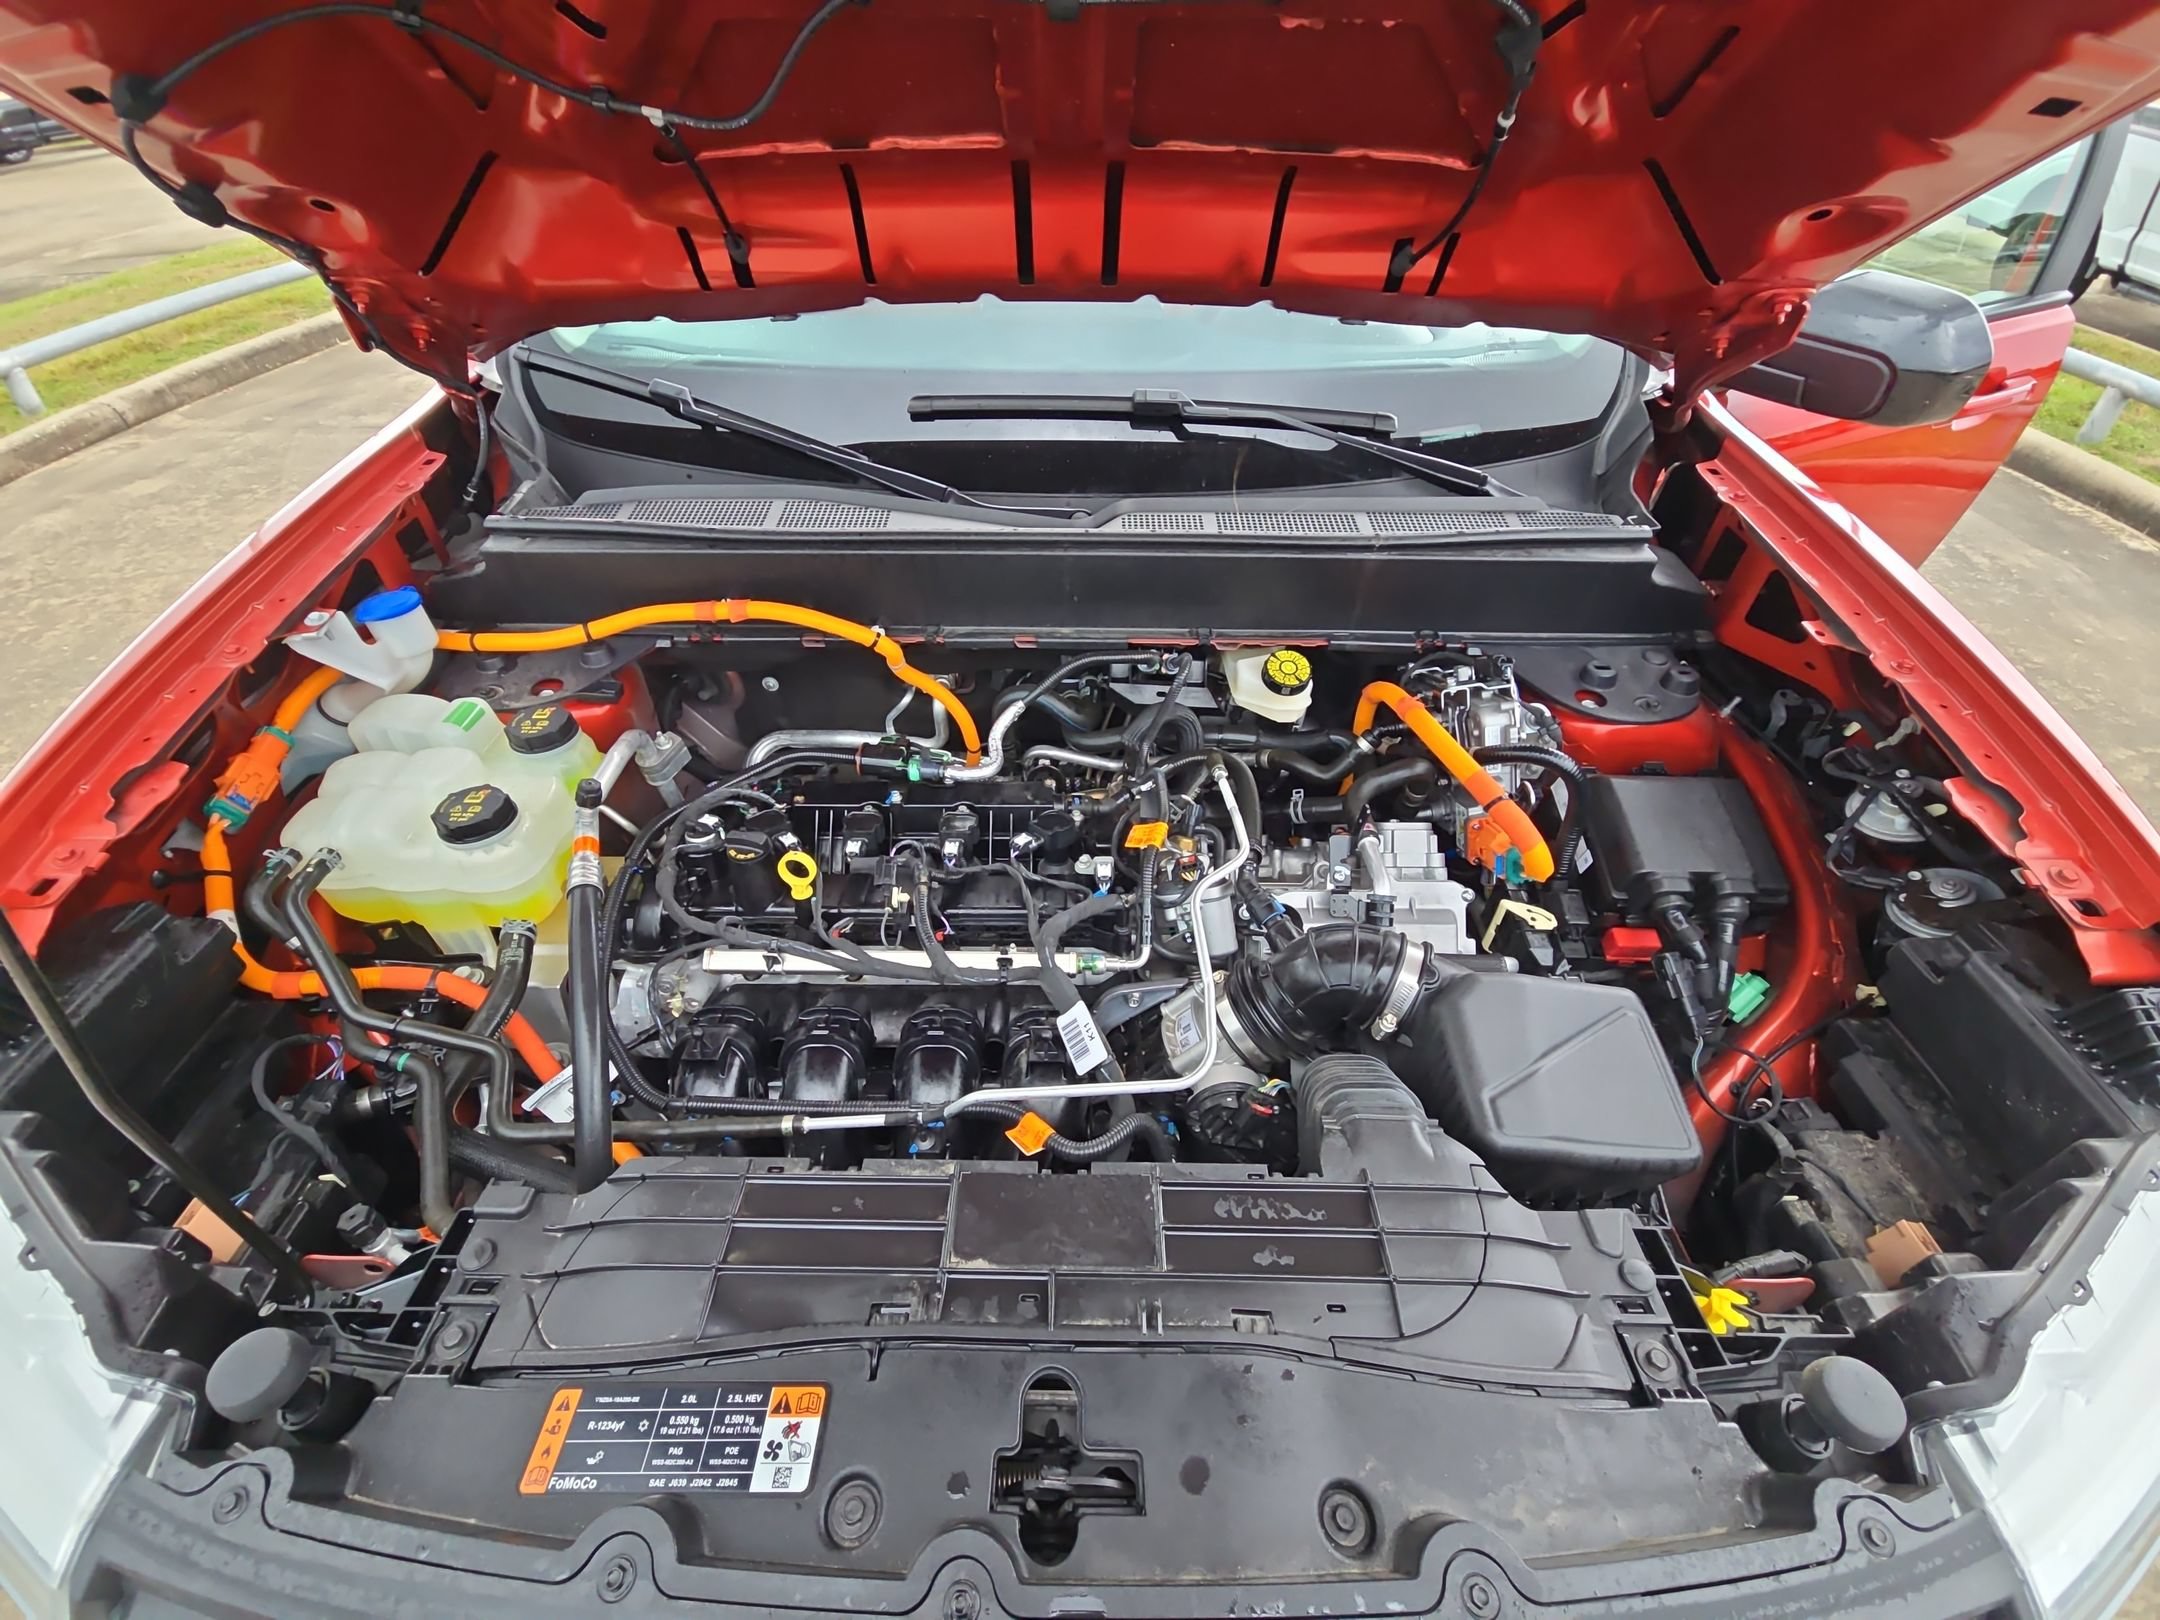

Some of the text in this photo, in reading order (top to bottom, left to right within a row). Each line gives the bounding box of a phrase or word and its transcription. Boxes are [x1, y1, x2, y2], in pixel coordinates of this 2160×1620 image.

[1083, 1022, 1095, 1041] K11
[680, 1395, 698, 1404] 2.0L
[727, 1394, 763, 1404] 2.5L HEV
[669, 1416, 700, 1427] 0.550 kg
[724, 1414, 755, 1426] 0.500 kg
[587, 1420, 625, 1433] R-1234yf
[668, 1447, 683, 1455] PAG
[724, 1446, 740, 1455] POE
[548, 1476, 598, 1490] FoMoCo
[648, 1478, 738, 1488] SAE J639 J2842 J2845
